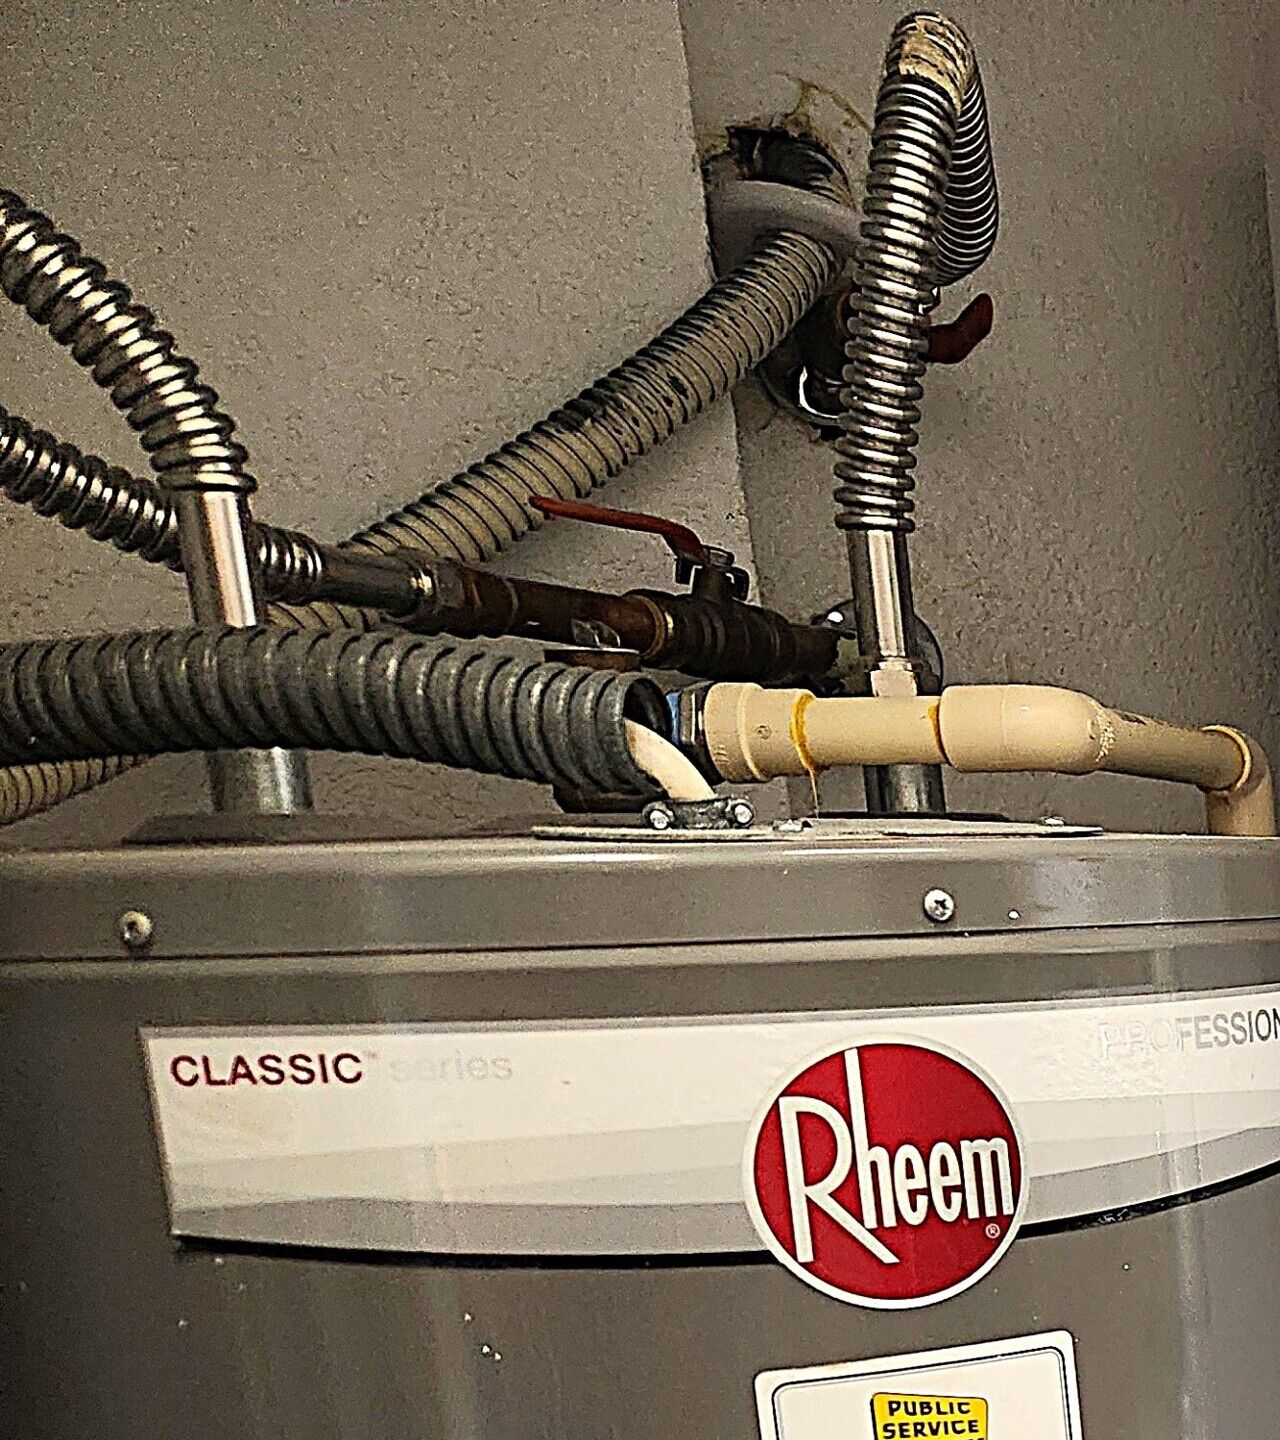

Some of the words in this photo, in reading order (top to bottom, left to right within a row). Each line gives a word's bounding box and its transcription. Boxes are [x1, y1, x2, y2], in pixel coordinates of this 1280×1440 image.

[170, 1052, 364, 1087] CLASSIC
[778, 1047, 1014, 1264] Rheem
[887, 1400, 972, 1417] PUBLIC
[882, 1418, 980, 1440] SERVICE
